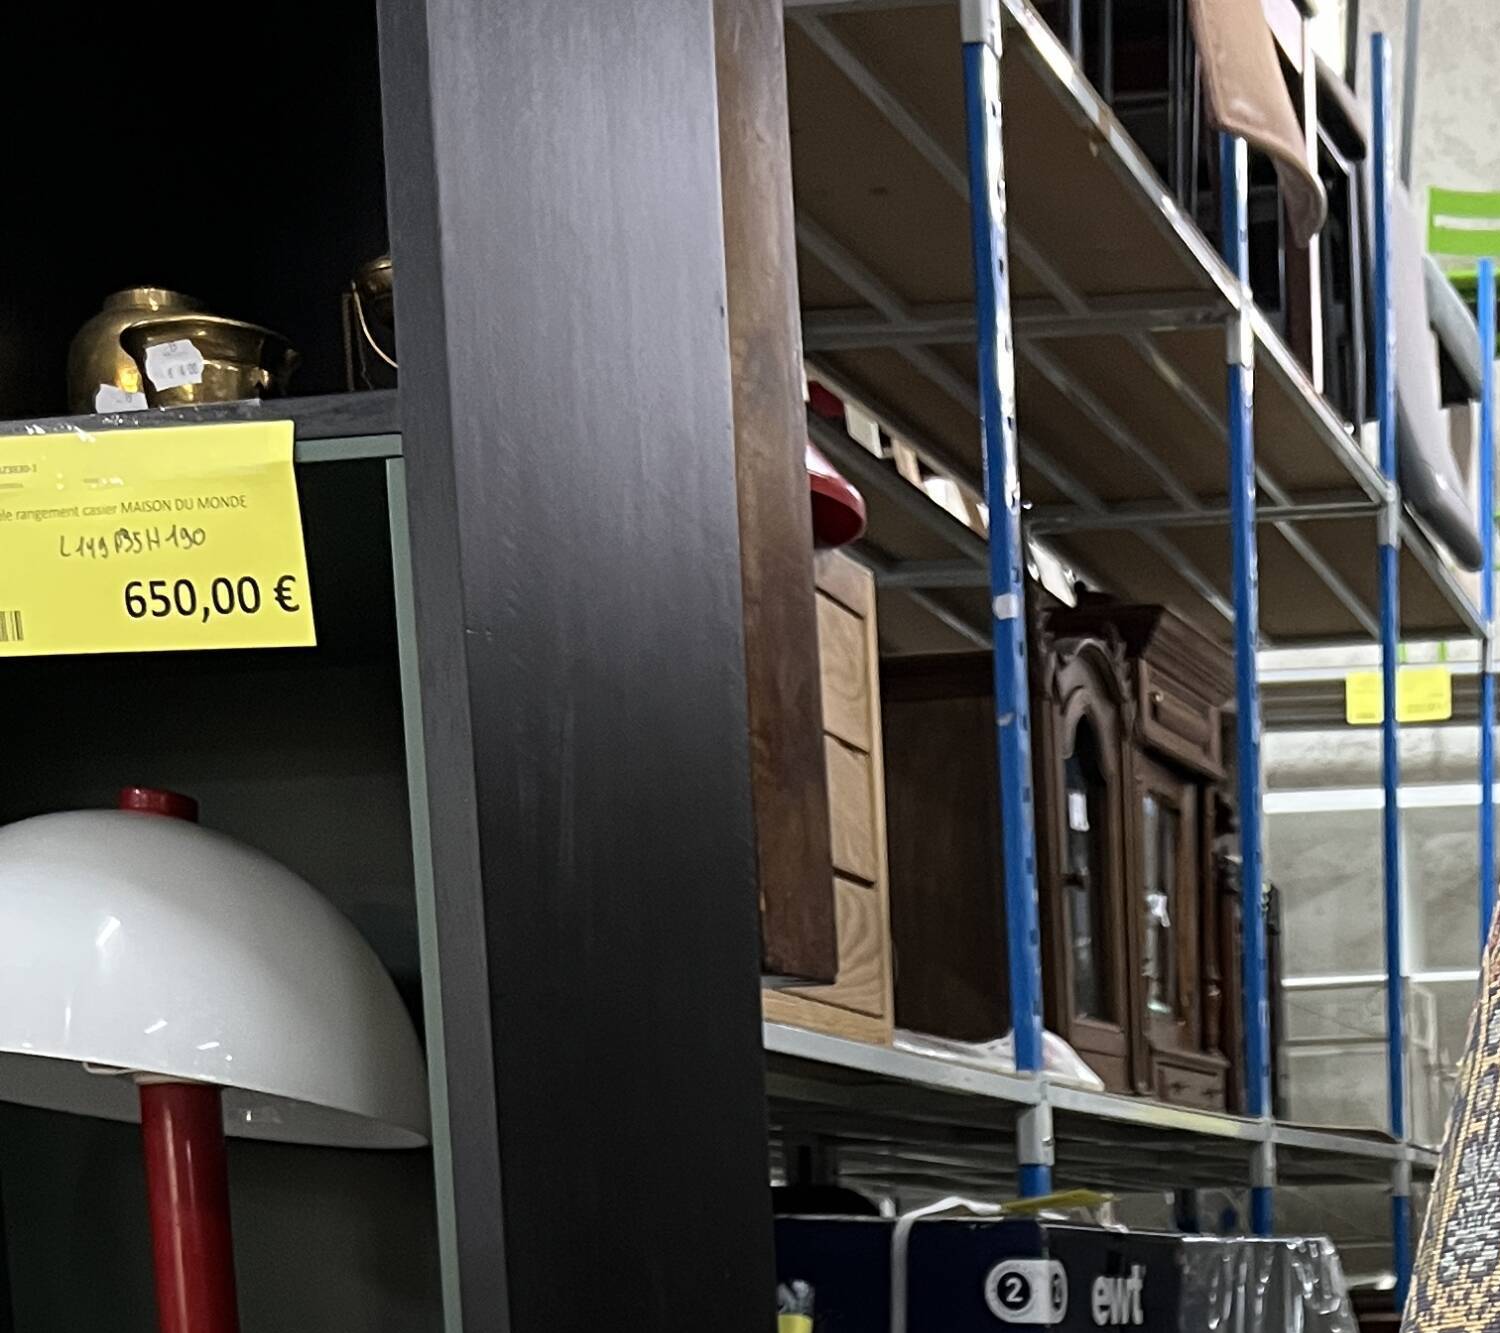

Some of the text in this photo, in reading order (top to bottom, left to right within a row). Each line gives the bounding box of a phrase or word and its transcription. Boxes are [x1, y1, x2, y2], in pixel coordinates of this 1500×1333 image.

[16, 506, 79, 522] rangement
[82, 505, 117, 517] casier
[120, 499, 172, 514] MAISON
[175, 498, 194, 512] DU
[197, 494, 248, 510] MONDE
[124, 574, 301, 624] 650,00 €
